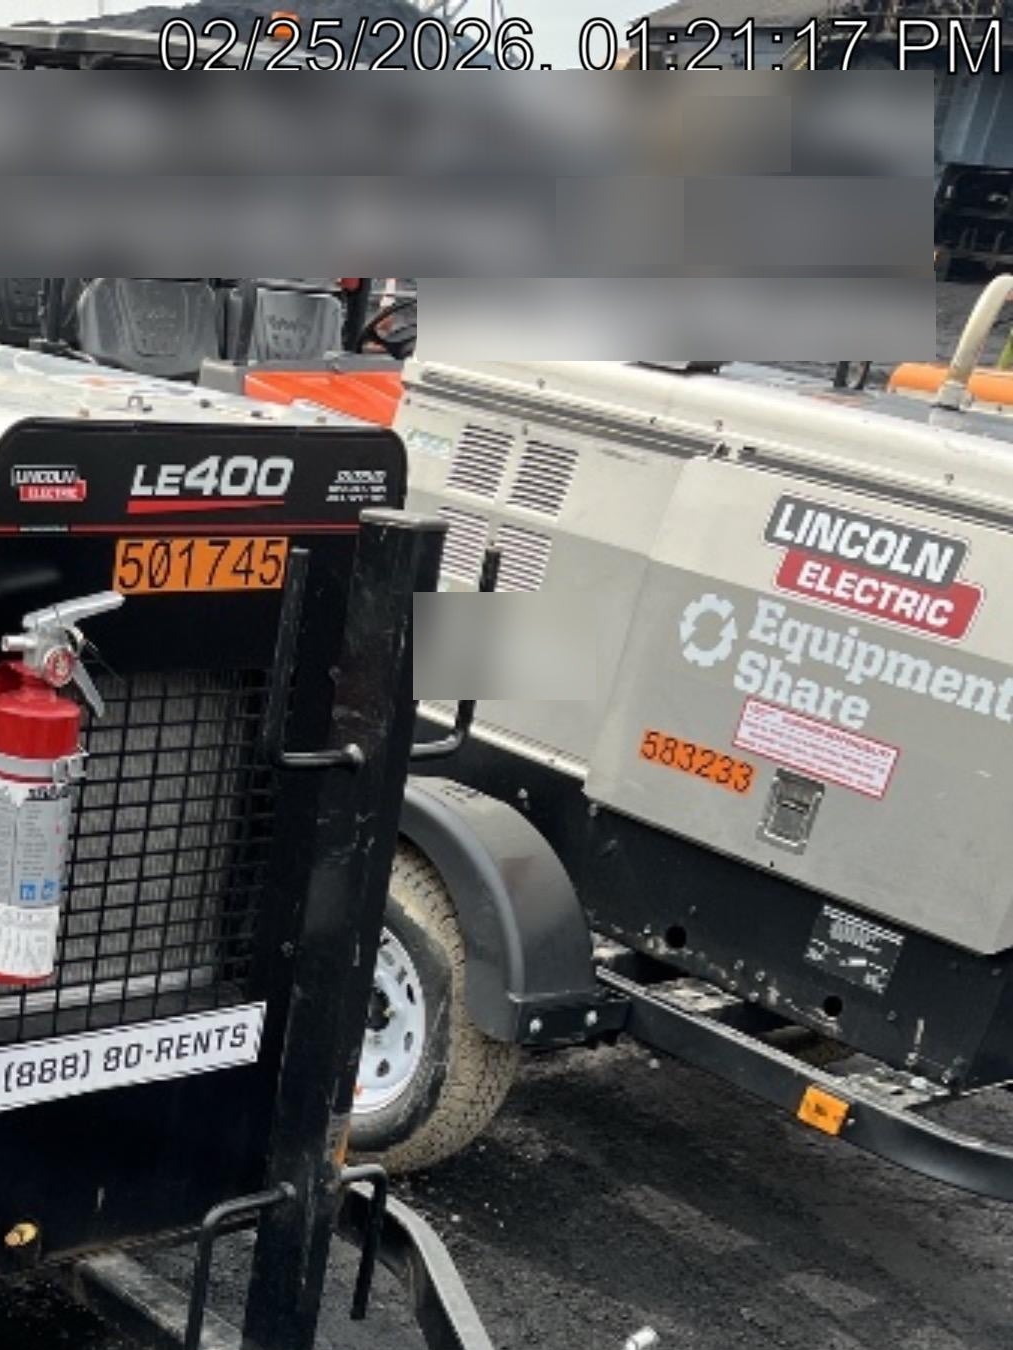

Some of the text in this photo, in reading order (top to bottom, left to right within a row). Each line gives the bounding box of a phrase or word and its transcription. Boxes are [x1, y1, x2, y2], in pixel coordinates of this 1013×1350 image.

[129, 455, 295, 496] LE400
[118, 538, 284, 588] 501745
[773, 503, 955, 583] LINCOLN
[796, 560, 955, 627] ELECTRIC
[734, 650, 870, 730] Share
[748, 597, 1013, 723] Equipment
[641, 731, 754, 793] 583233
[3, 1049, 90, 1092] (888)
